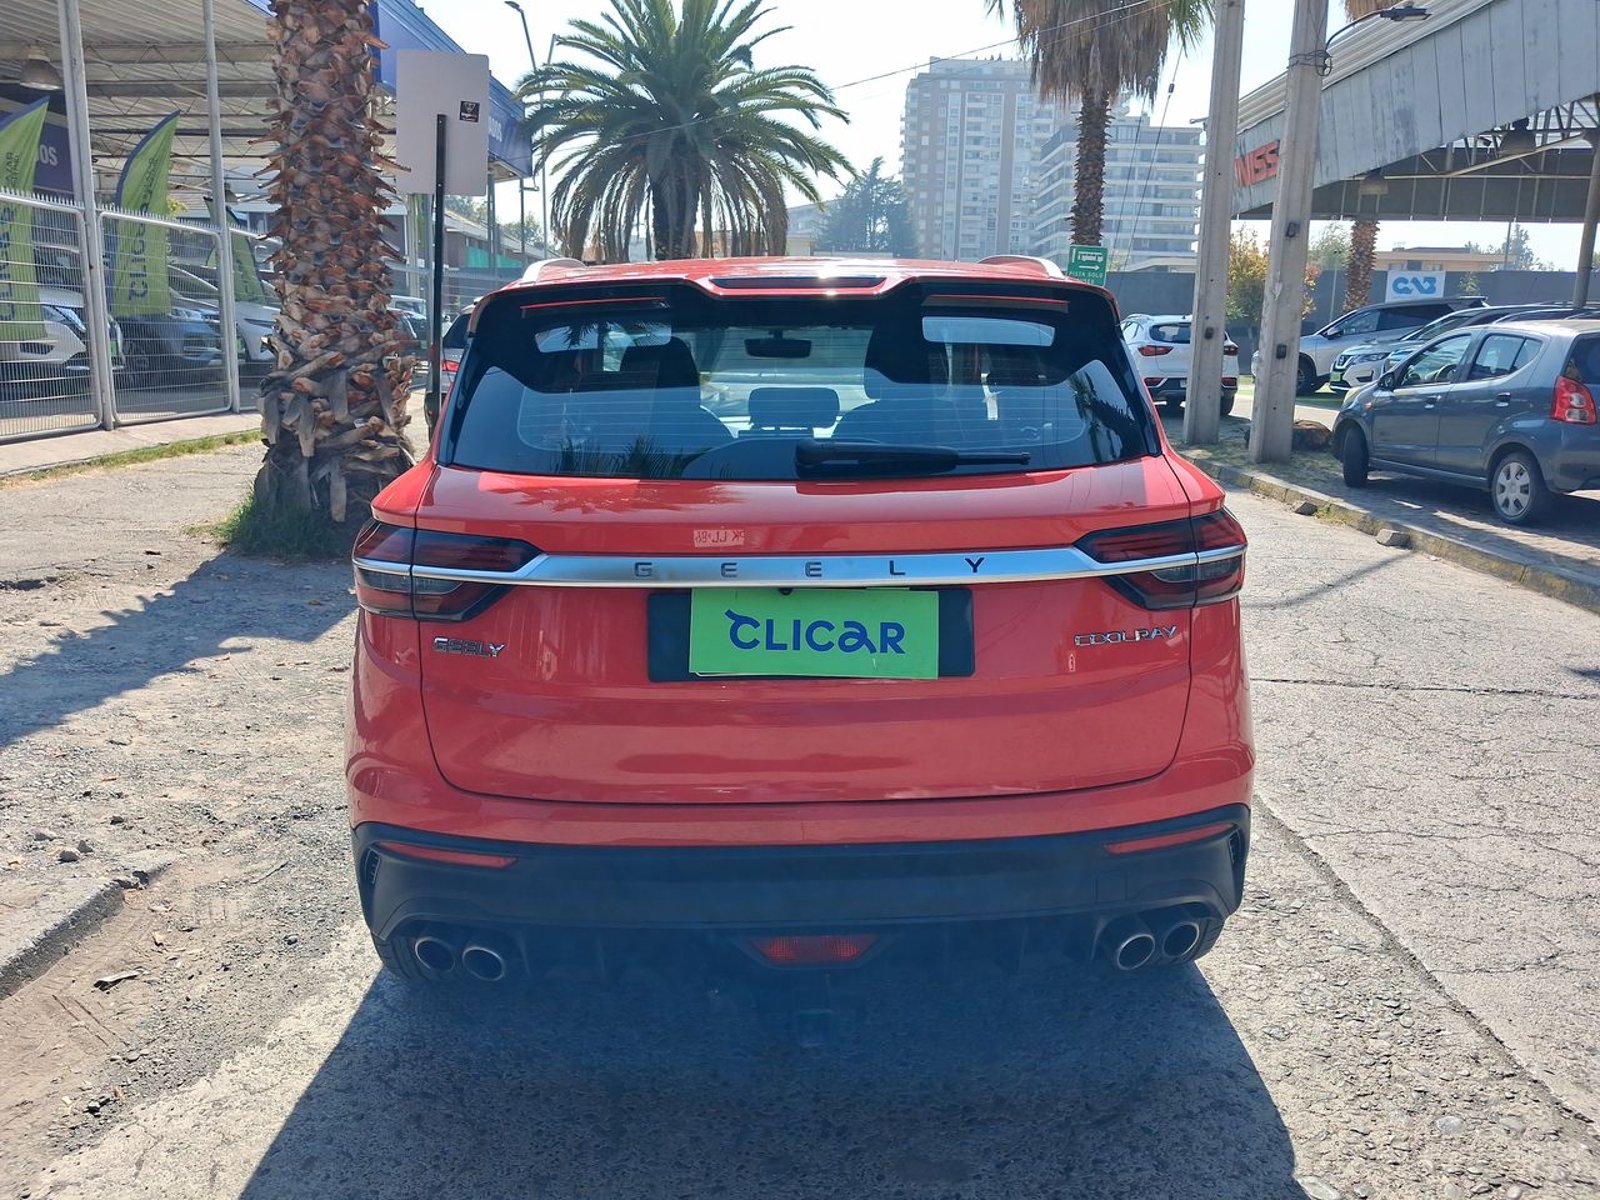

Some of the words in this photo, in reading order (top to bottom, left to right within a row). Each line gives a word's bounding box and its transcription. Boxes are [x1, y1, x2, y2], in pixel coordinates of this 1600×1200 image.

[634, 557, 985, 578] GEELY
[1074, 625, 1177, 646] COOLRAY
[434, 636, 505, 657] GEELY
